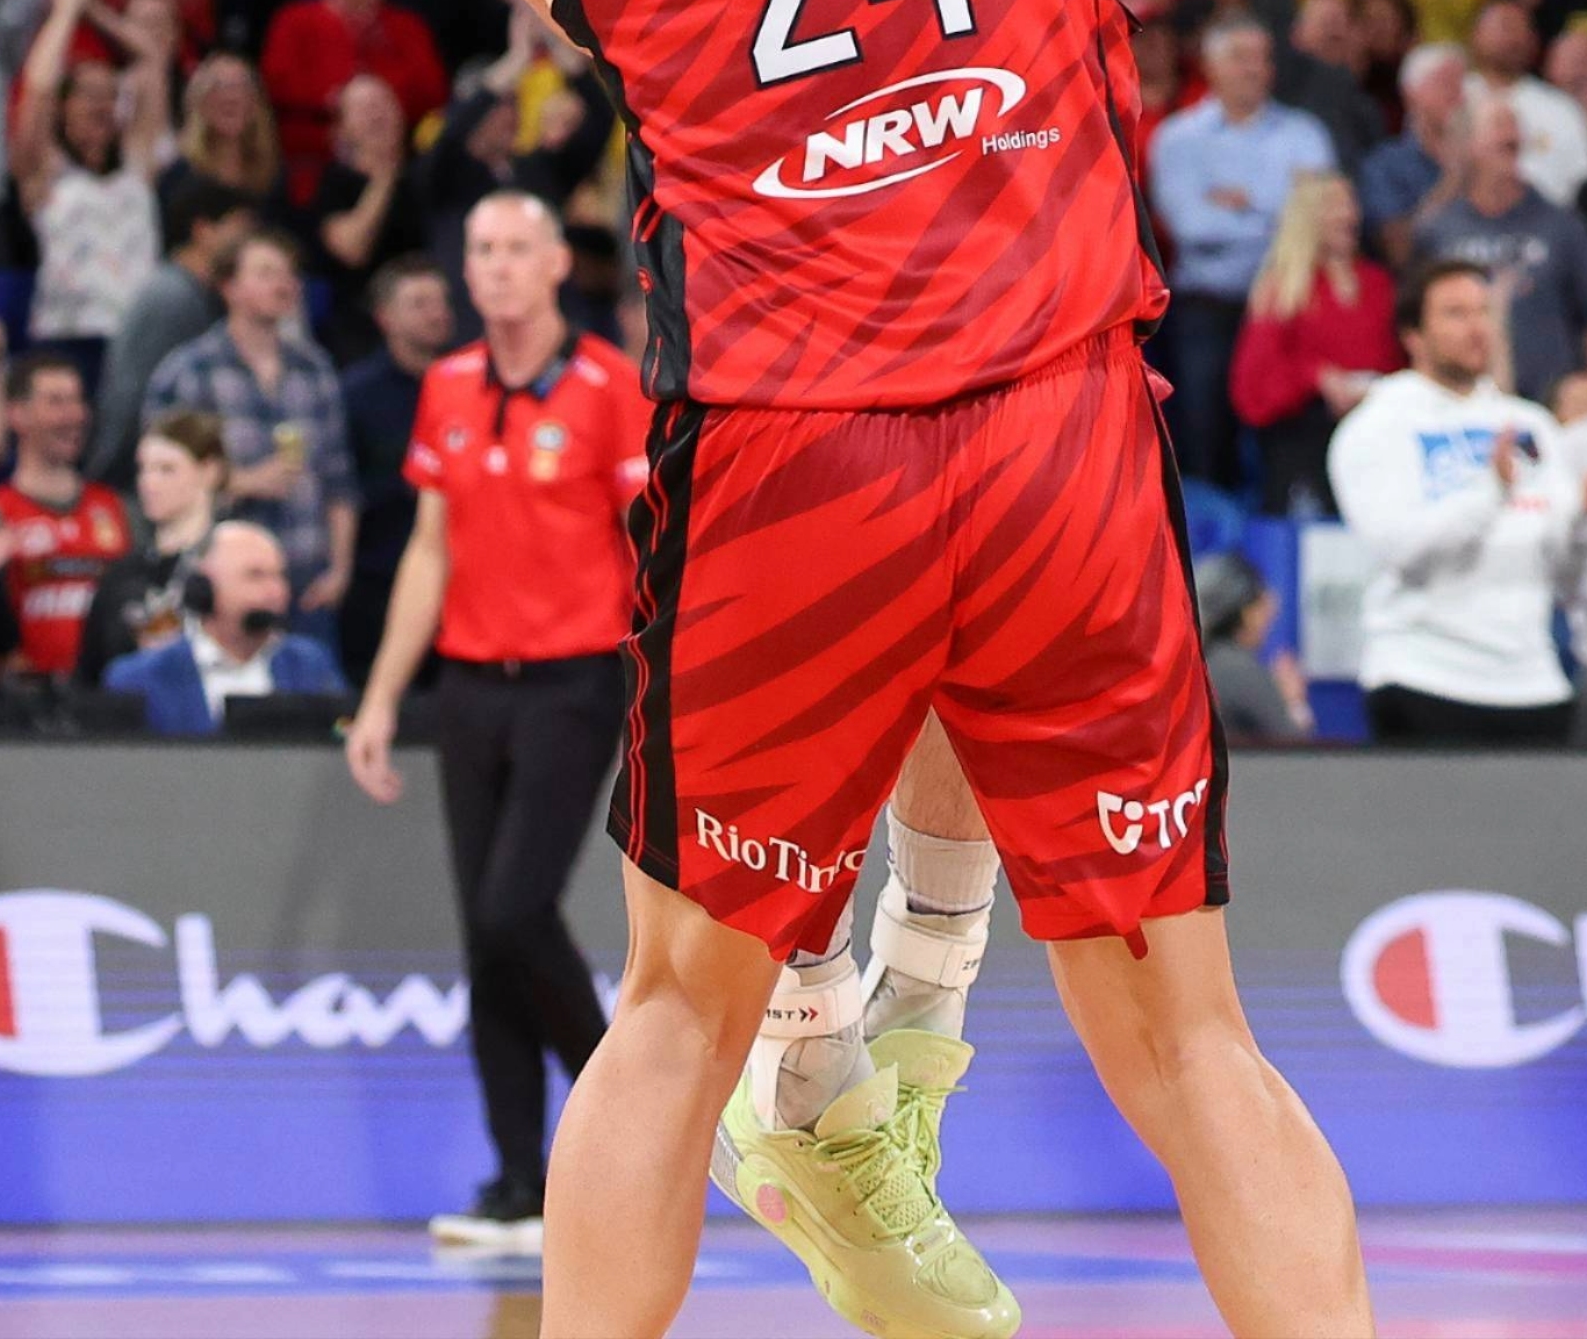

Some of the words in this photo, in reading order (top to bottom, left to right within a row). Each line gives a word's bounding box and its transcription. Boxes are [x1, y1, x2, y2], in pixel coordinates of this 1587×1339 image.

[802, 87, 984, 183] NRW
[981, 125, 1061, 157] Holdings
[695, 807, 767, 870] Rio
